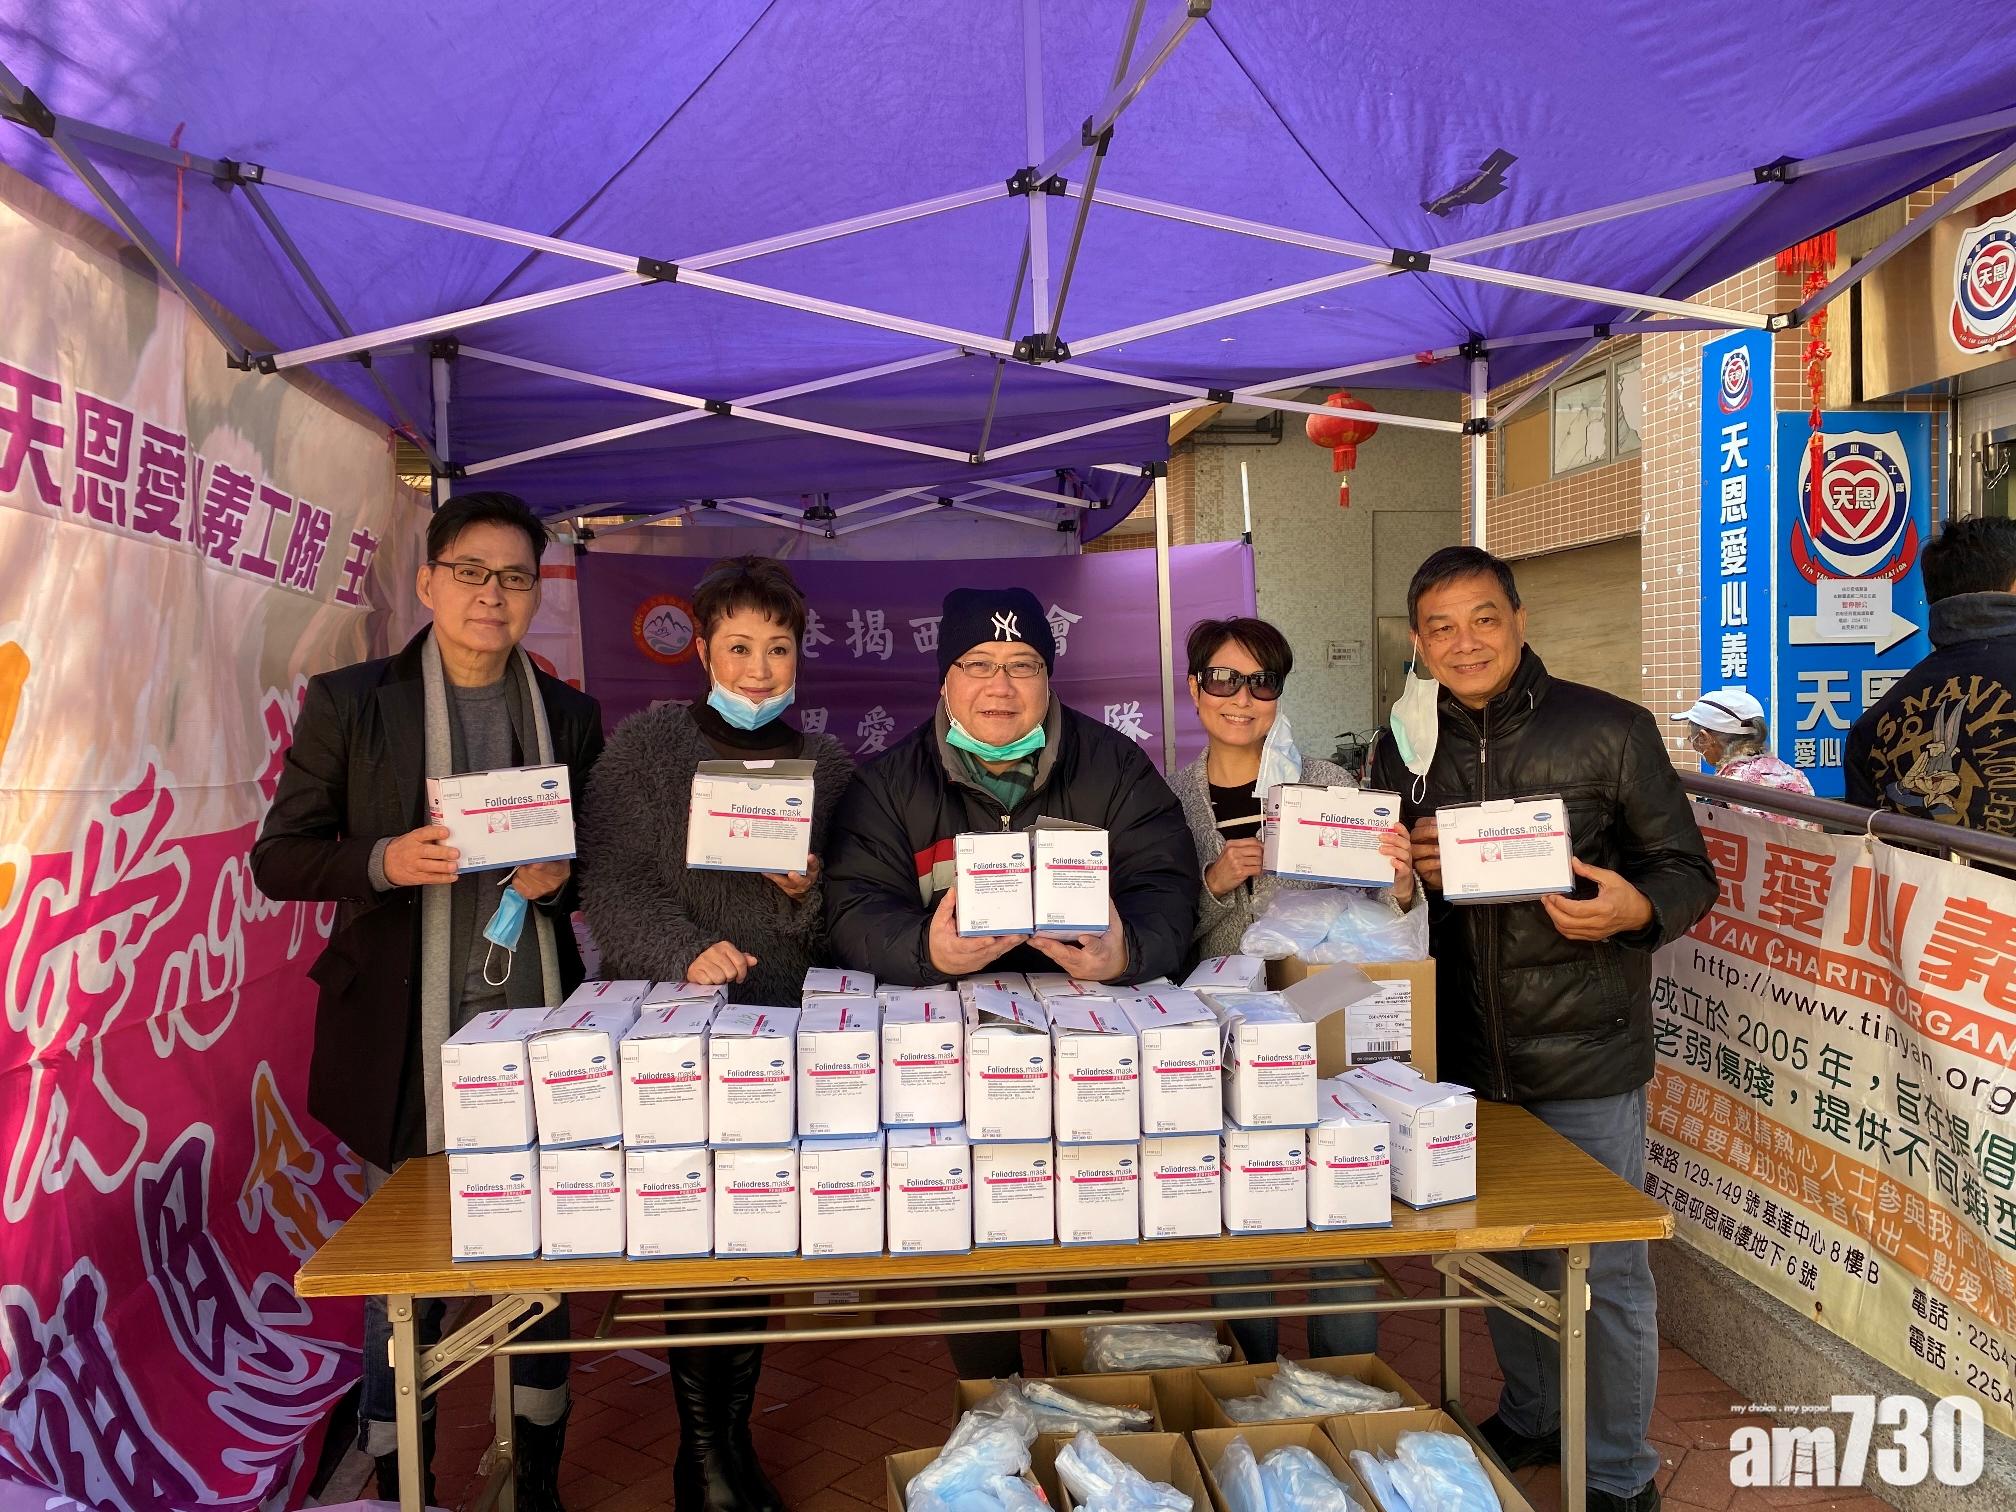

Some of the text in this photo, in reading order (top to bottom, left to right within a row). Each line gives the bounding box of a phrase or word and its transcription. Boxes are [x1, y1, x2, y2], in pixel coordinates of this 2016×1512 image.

[1980, 262, 2007, 287] 天恩
[1833, 486, 1876, 510] 天恩
[1720, 421, 1748, 693] 天恩愛心義
[1709, 916, 1758, 954] YAN
[1766, 938, 1892, 1001] CHARITY
[1652, 976, 1730, 1040] 成立於
[1737, 1014, 1809, 1070] 2005
[1684, 1160, 1742, 1204] 129-149
[1830, 1240, 1841, 1262] 8
[1867, 1260, 1879, 1284] B
[1786, 1255, 1797, 1275] 6
